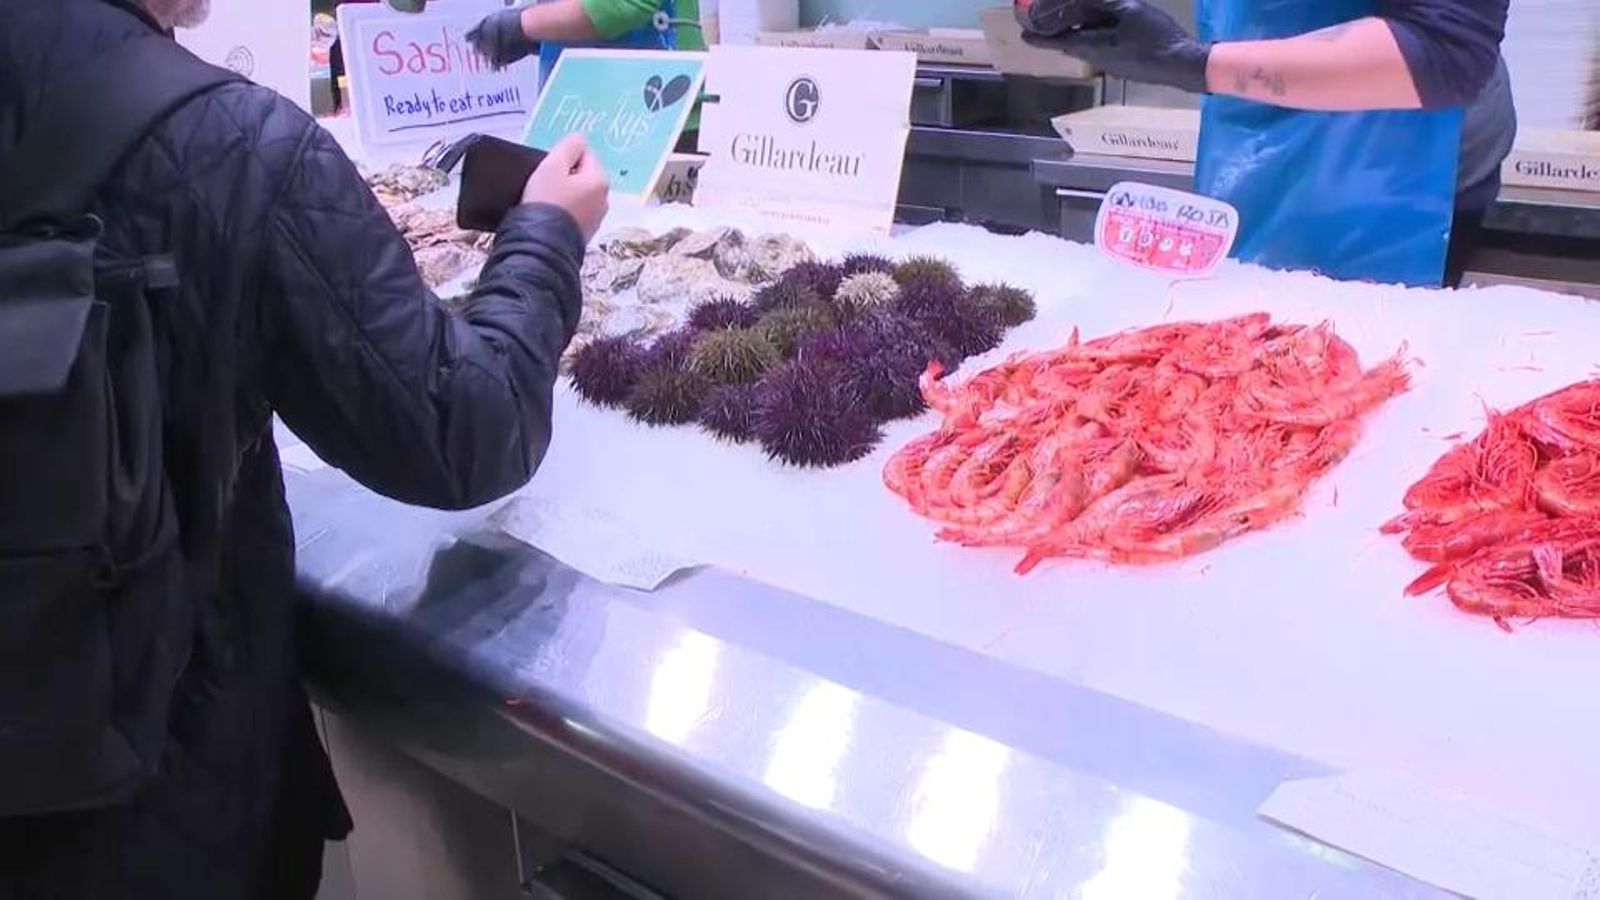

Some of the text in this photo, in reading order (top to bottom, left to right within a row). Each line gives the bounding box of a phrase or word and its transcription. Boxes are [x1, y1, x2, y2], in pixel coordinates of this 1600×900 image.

[384, 93, 431, 119] Ready
[431, 87, 446, 114] to
[449, 89, 473, 113] eat
[548, 94, 606, 132] Fine
[731, 133, 861, 177] Gillardeau
[1101, 131, 1179, 150] Gillardeau
